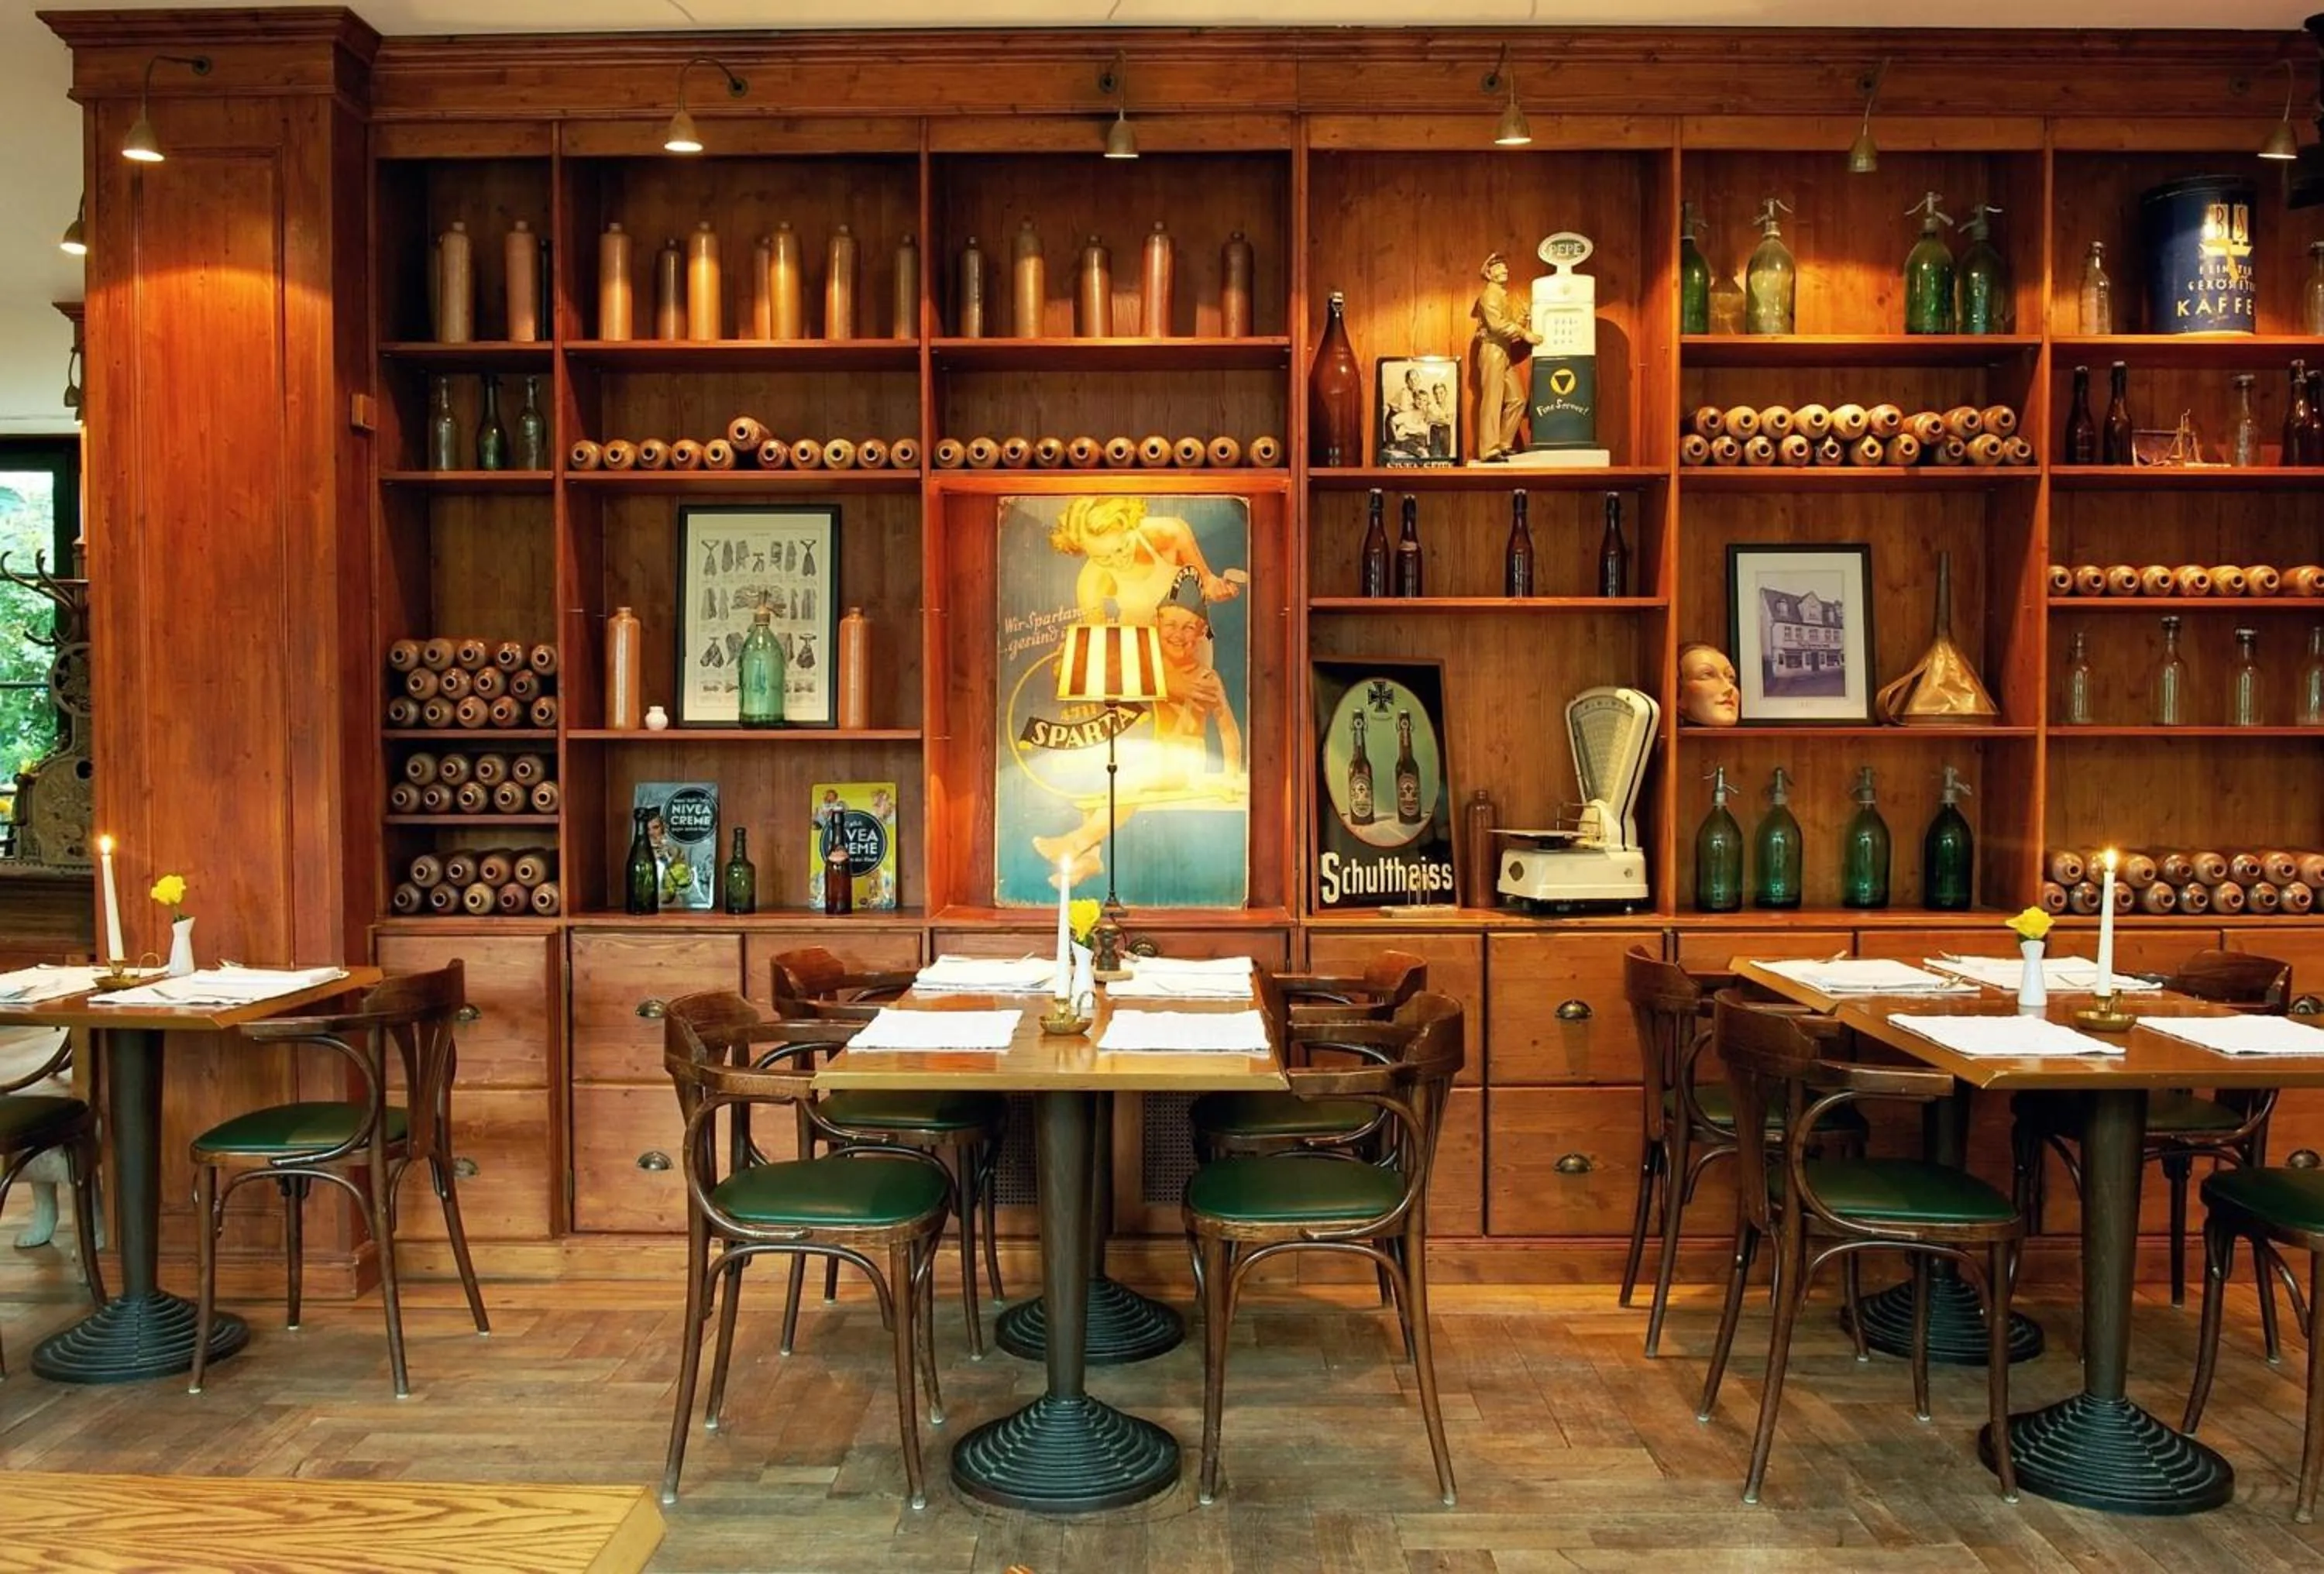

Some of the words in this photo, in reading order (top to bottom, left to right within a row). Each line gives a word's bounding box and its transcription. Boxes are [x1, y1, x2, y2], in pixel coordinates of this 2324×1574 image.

[1030, 705, 1139, 749] SPARTA
[672, 803, 710, 815] NIVEA
[670, 816, 710, 825] CREME
